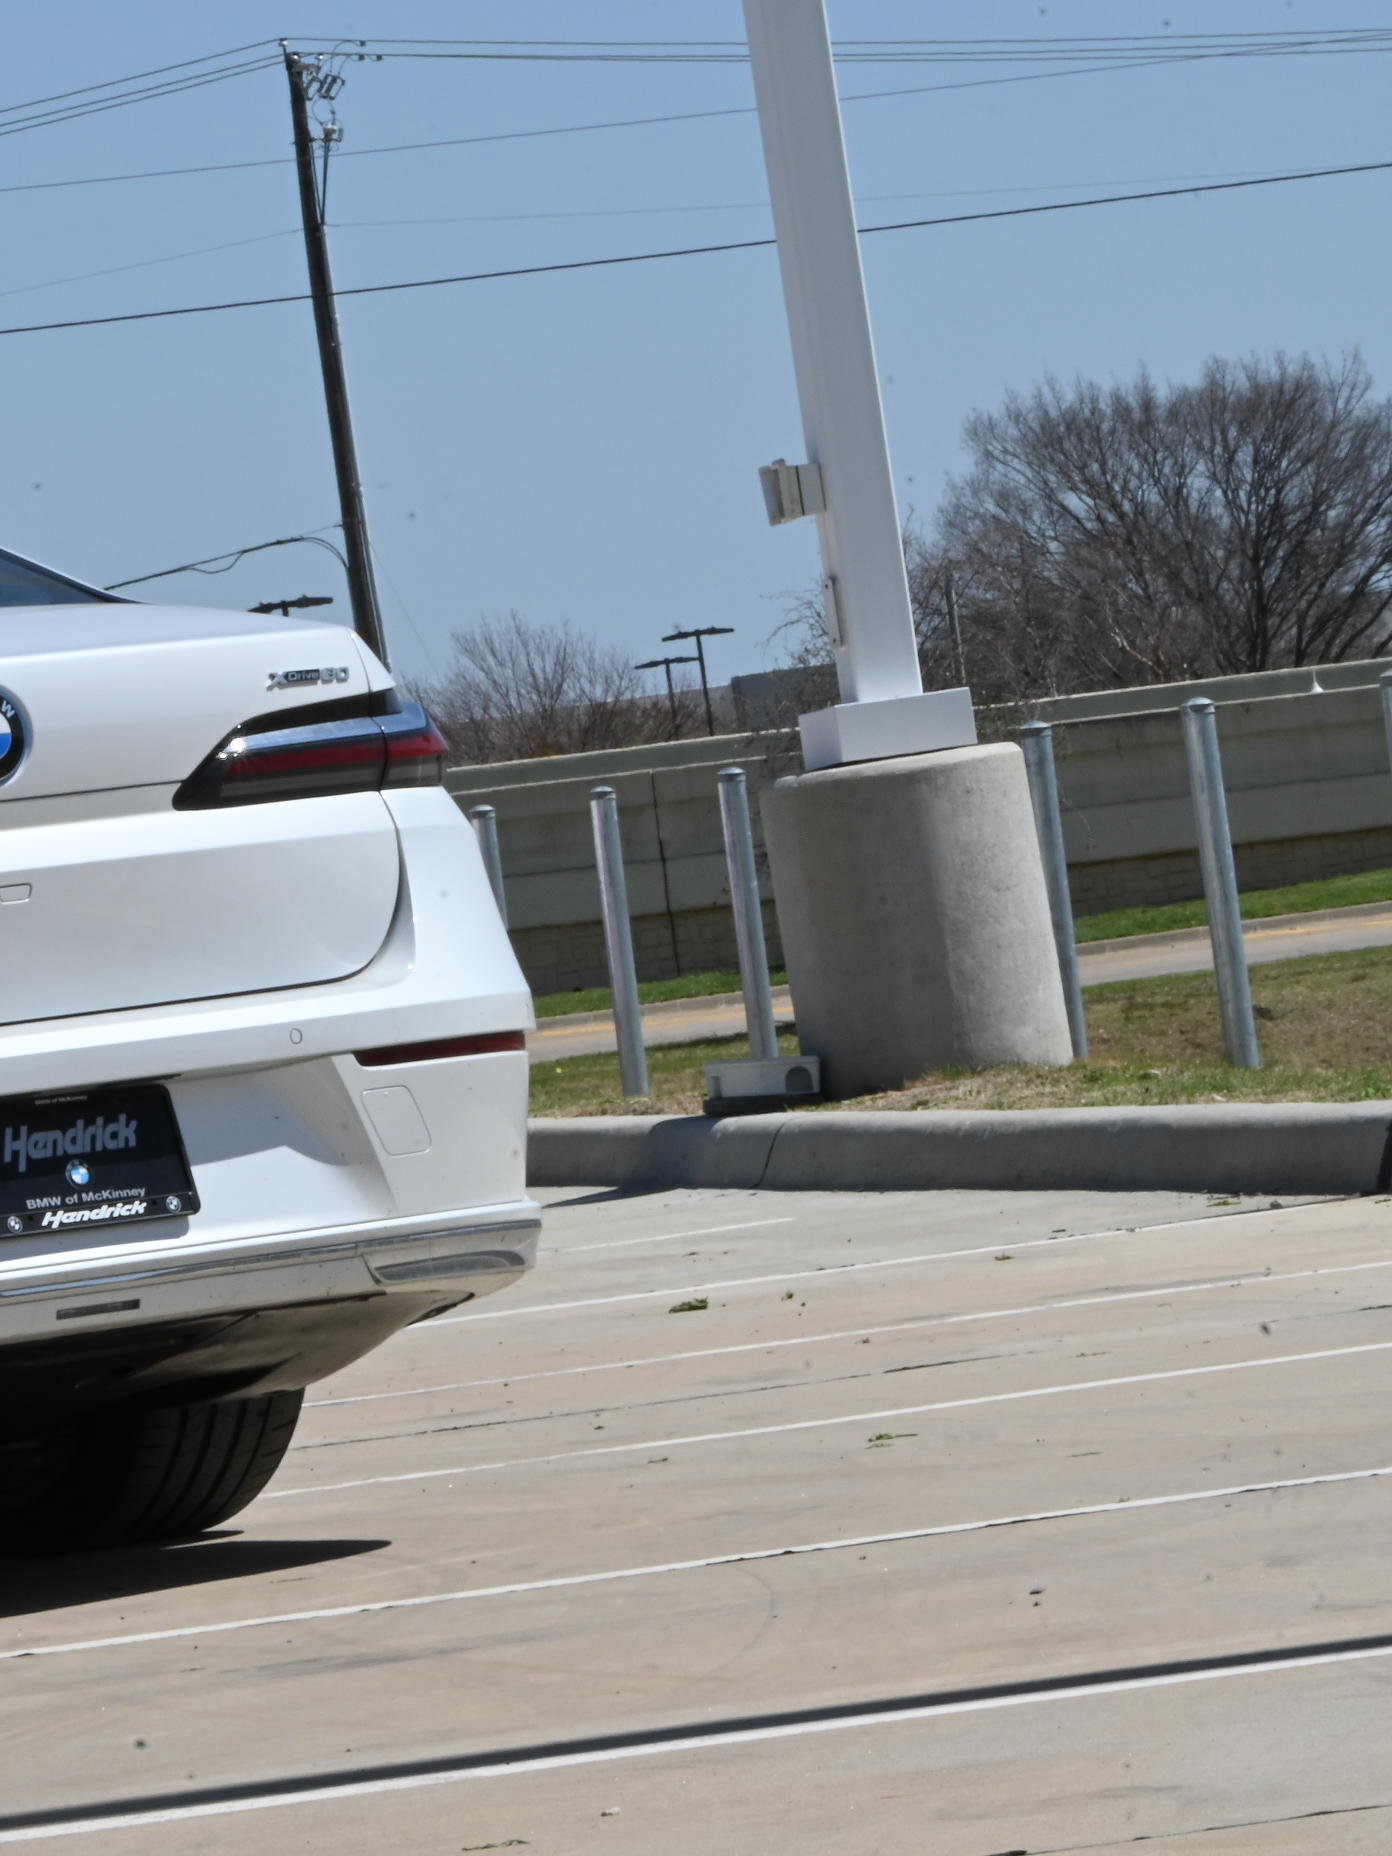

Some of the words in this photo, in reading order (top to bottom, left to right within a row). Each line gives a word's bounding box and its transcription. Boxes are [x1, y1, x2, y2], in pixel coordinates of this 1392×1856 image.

[4, 1113, 137, 1172] Hendrick
[26, 1197, 62, 1210] BMW
[66, 1192, 79, 1205] of
[82, 1187, 146, 1203] McKinney
[41, 1200, 147, 1229] Hendrick
